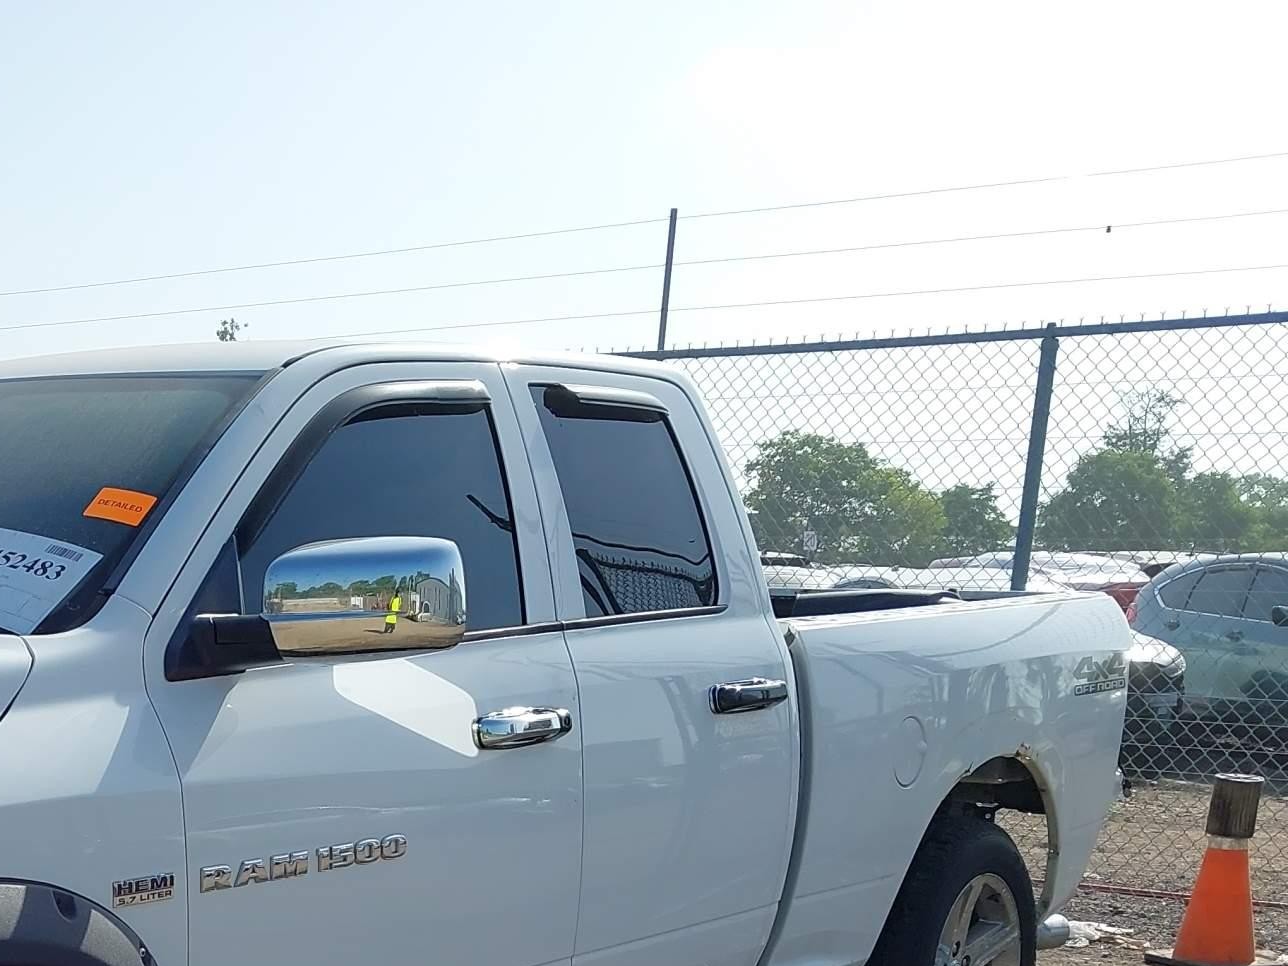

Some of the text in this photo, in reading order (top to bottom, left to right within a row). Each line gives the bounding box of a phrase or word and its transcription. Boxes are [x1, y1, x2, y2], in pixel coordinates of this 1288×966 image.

[98, 498, 143, 513] DETAILED
[200, 833, 408, 893] RAM 1500
[114, 873, 175, 897] HEMI
[117, 888, 173, 906] 5.7 LITER
